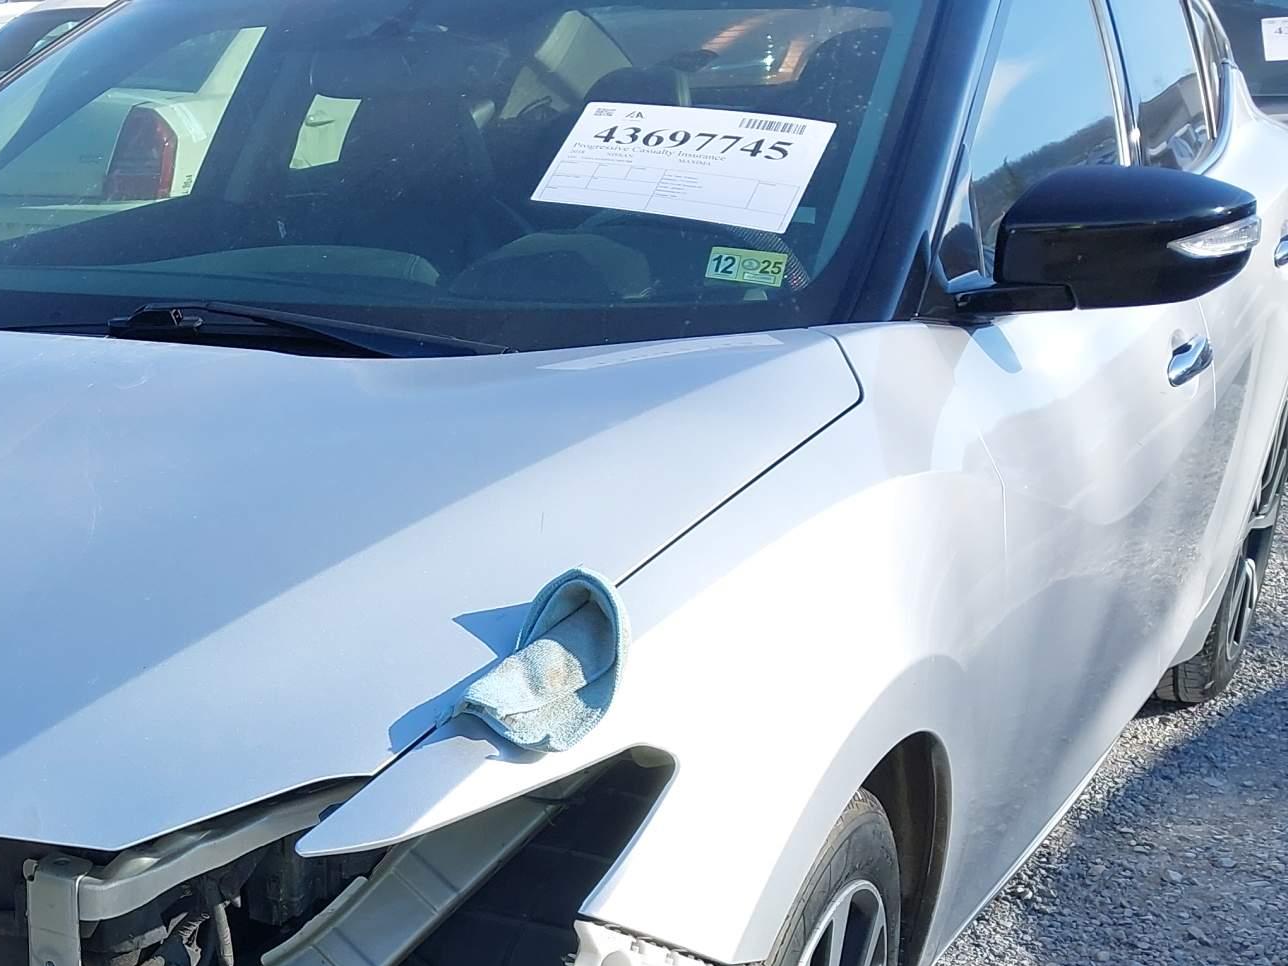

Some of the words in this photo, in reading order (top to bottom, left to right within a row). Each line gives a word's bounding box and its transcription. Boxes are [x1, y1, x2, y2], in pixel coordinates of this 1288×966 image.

[573, 142, 630, 153] Progressive
[632, 146, 674, 157] Casualty
[678, 150, 727, 161] Insurance
[593, 125, 793, 161] 43697745
[712, 254, 736, 275] 12
[760, 259, 784, 275] 25
